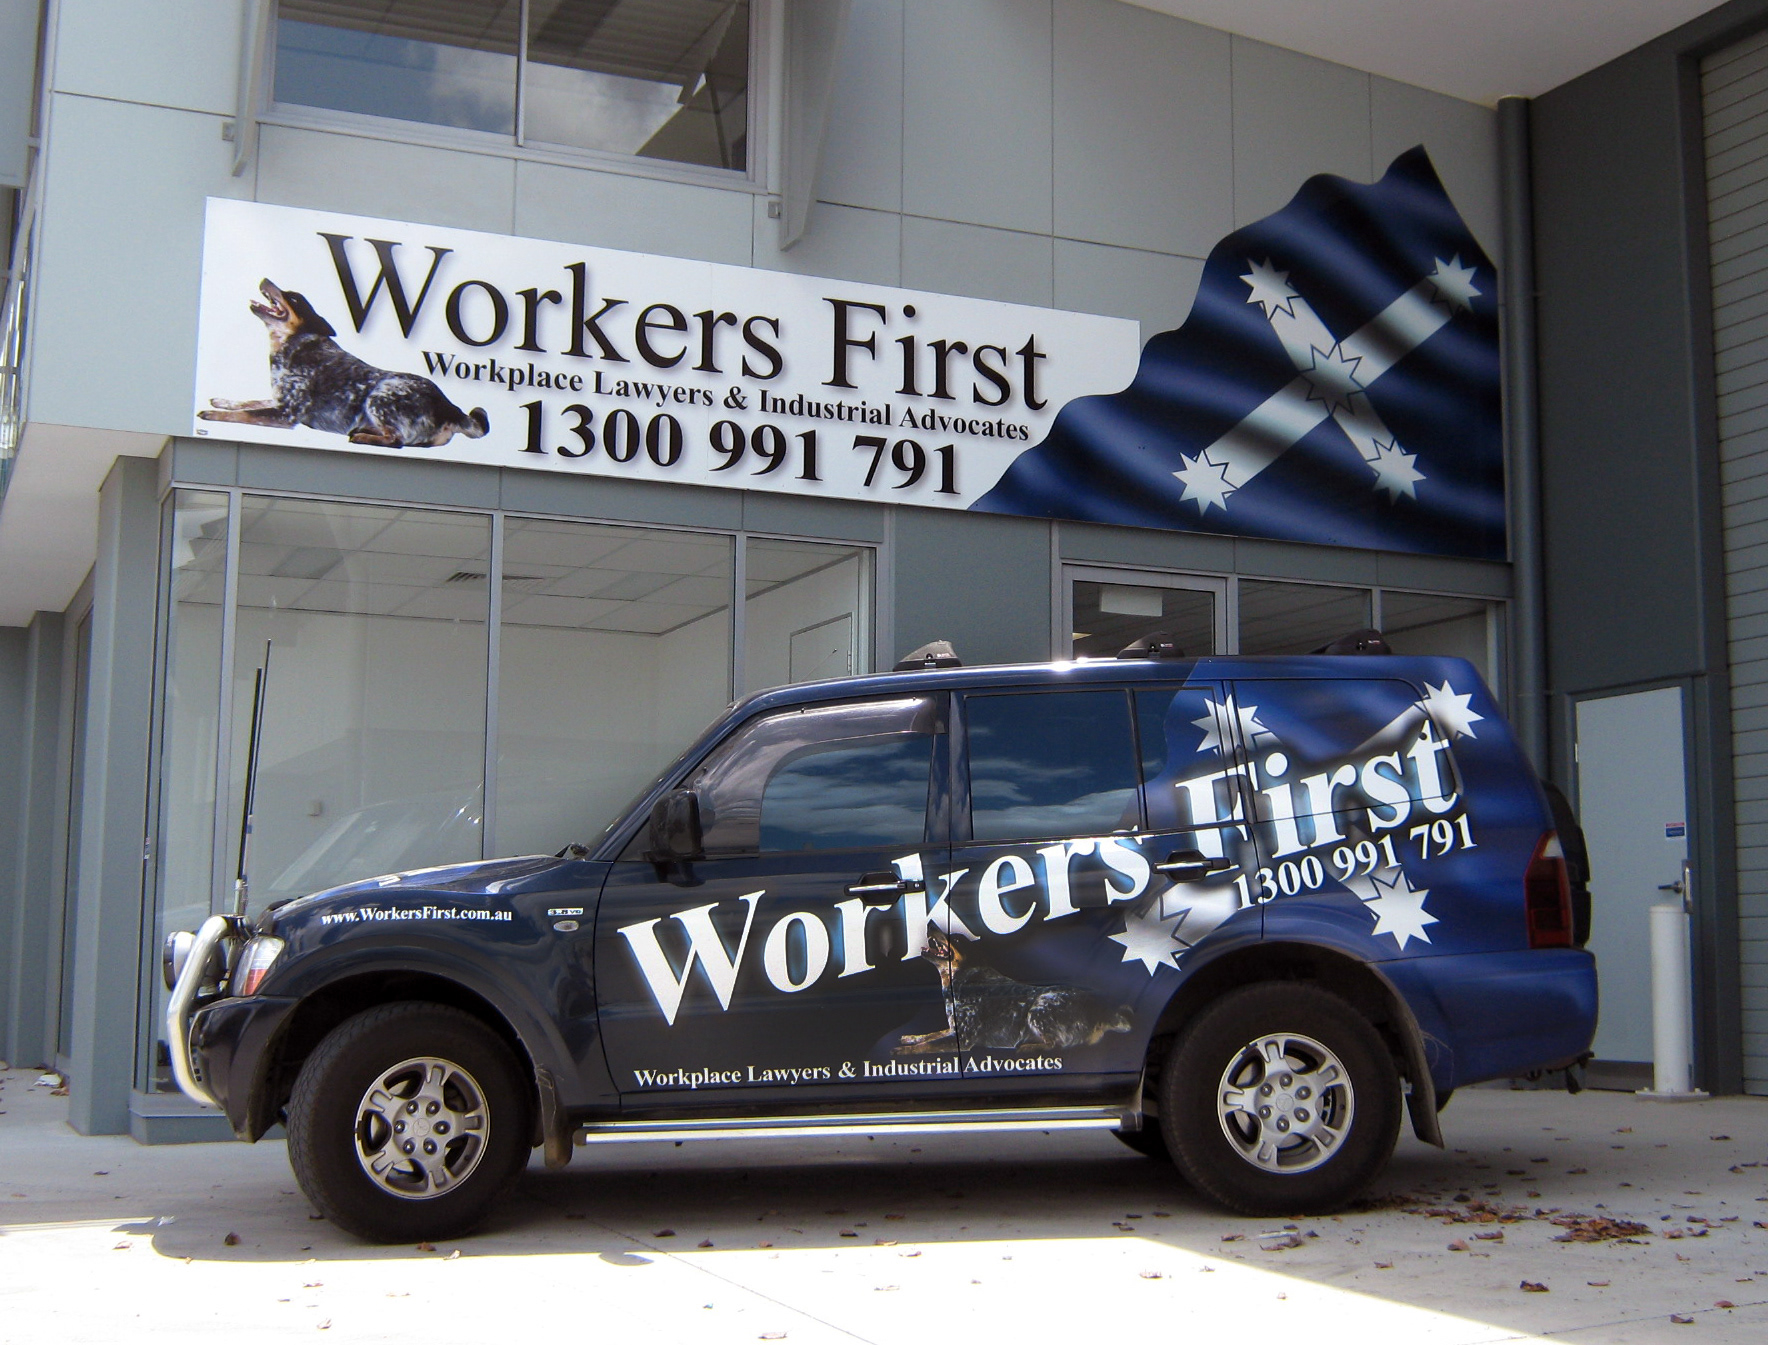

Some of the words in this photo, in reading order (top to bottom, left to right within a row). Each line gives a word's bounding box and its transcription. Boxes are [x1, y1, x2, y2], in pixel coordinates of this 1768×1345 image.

[317, 232, 783, 380] Workers
[821, 297, 1048, 411] First
[421, 351, 583, 391] Workplace
[593, 370, 714, 407] Lawyers
[723, 385, 748, 411] &
[759, 388, 891, 427] Industrial
[899, 406, 1029, 441] Advocates
[517, 400, 683, 467] 1300
[709, 420, 823, 482] 991
[852, 435, 960, 495] 791
[617, 825, 1149, 1026] Workers
[1175, 720, 1459, 877] First
[1232, 856, 1324, 911] 1300
[1333, 834, 1402, 882] 991
[1409, 813, 1478, 860] 791
[321, 906, 513, 925] www.WorkersFirst.com.au
[633, 1068, 742, 1089] Workplace
[746, 1063, 831, 1085] Lawyers
[838, 1062, 857, 1079] &
[863, 1057, 959, 1078] Industrial
[963, 1055, 1063, 1073] Advocates
